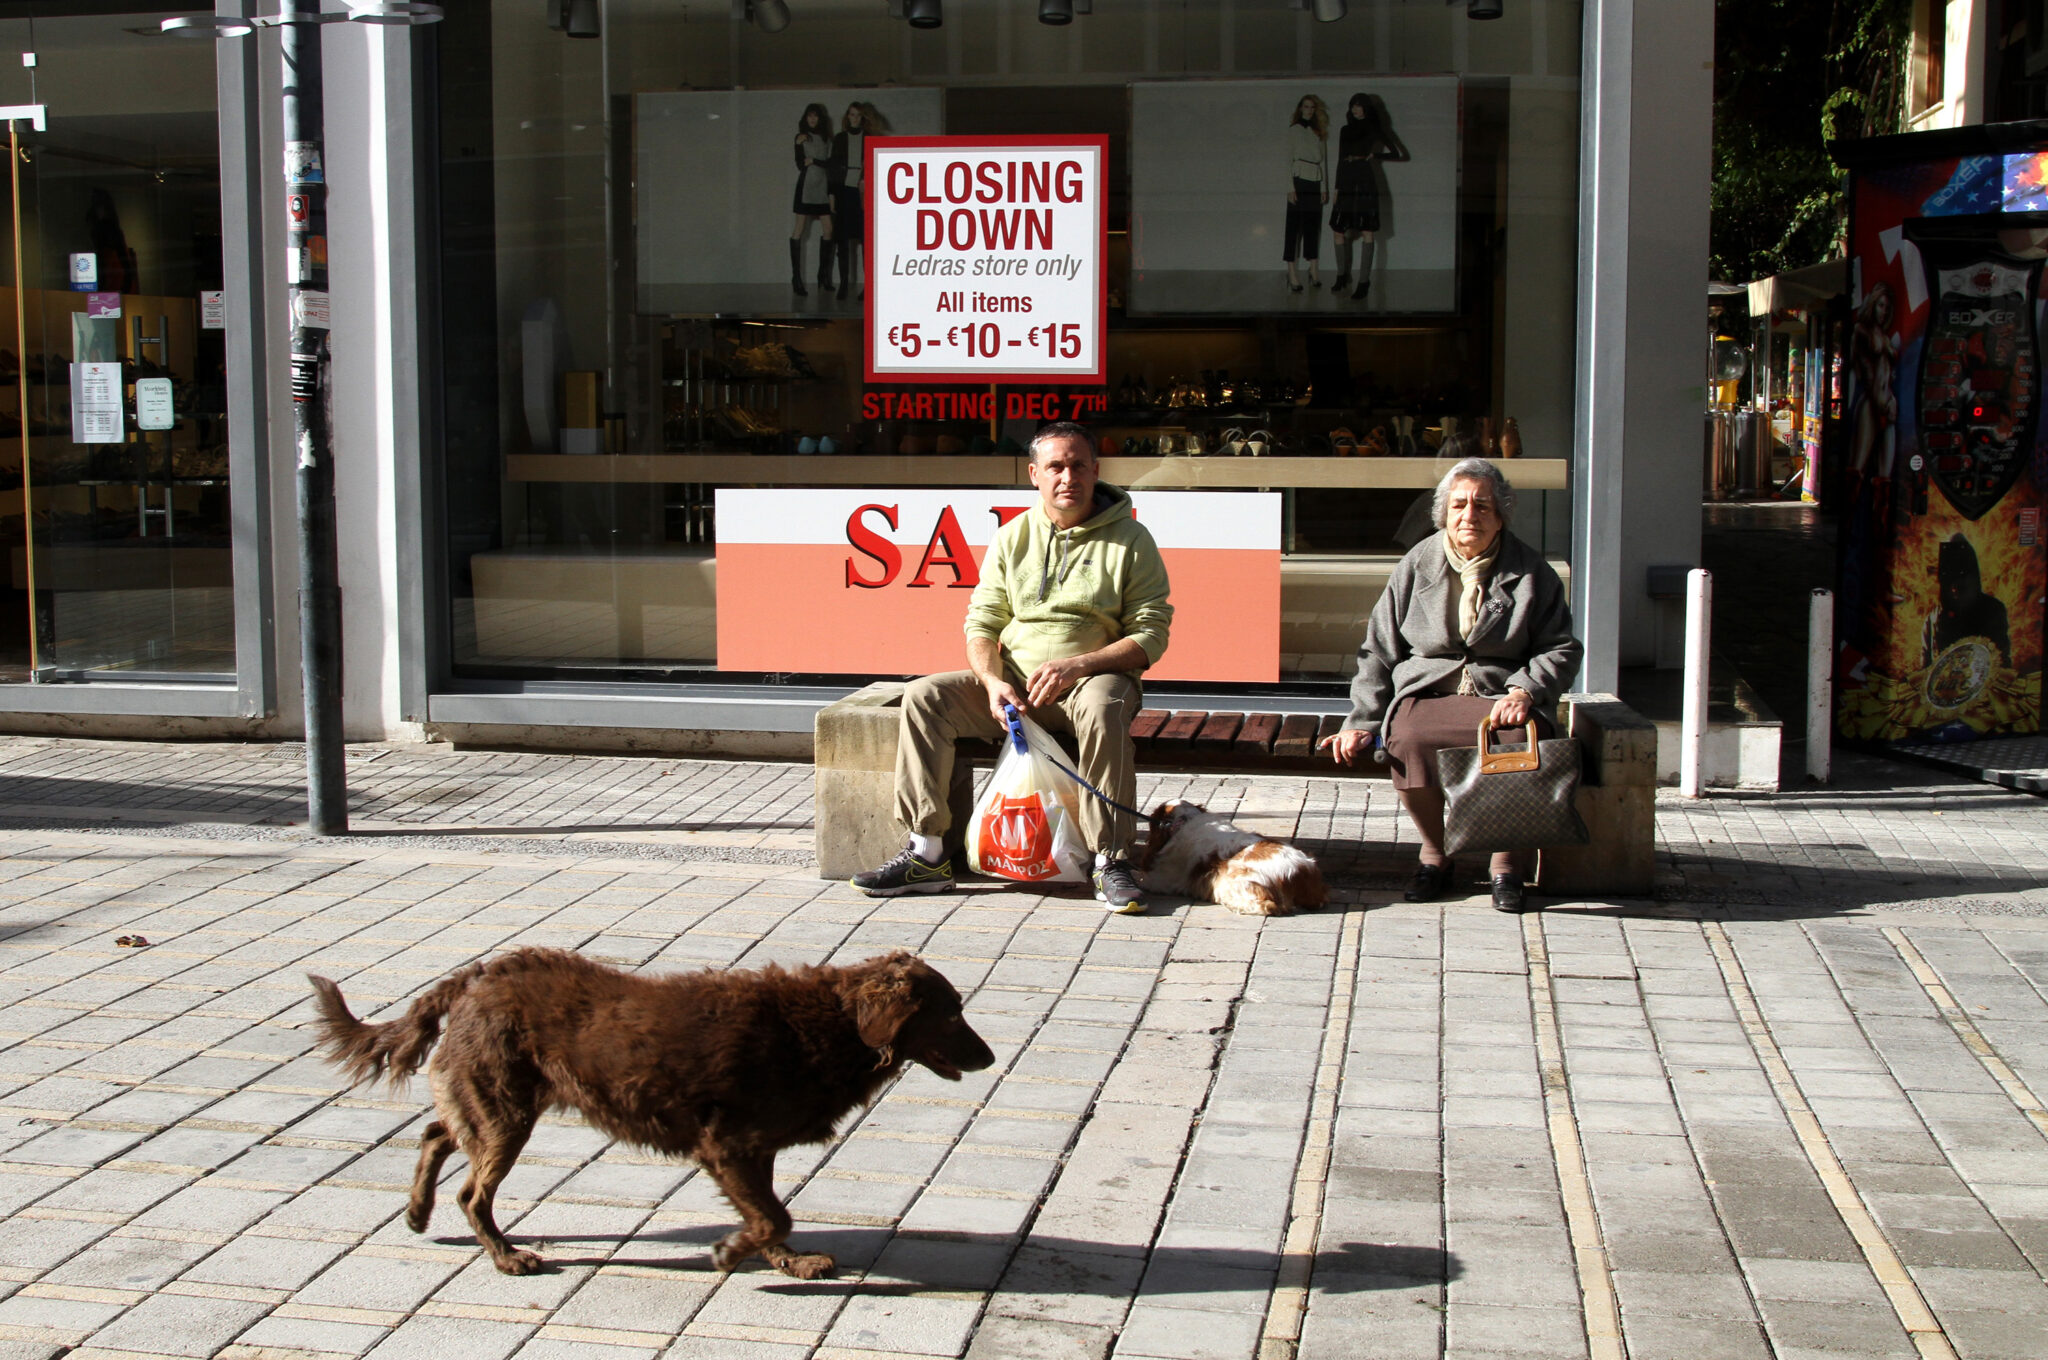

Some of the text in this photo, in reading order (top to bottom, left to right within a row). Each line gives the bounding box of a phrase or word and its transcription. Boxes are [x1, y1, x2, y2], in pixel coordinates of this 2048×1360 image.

[887, 160, 1083, 204] CLOSING
[916, 208, 1053, 251] DOWN
[892, 254, 1082, 281] Ledras store only
[936, 291, 1033, 313] All items
[1948, 308, 2017, 327] BOXER
[888, 323, 922, 358] €5
[947, 322, 1001, 358] €10
[1028, 322, 1082, 358] €15
[863, 392, 1107, 420] STARTING DEC 7TH
